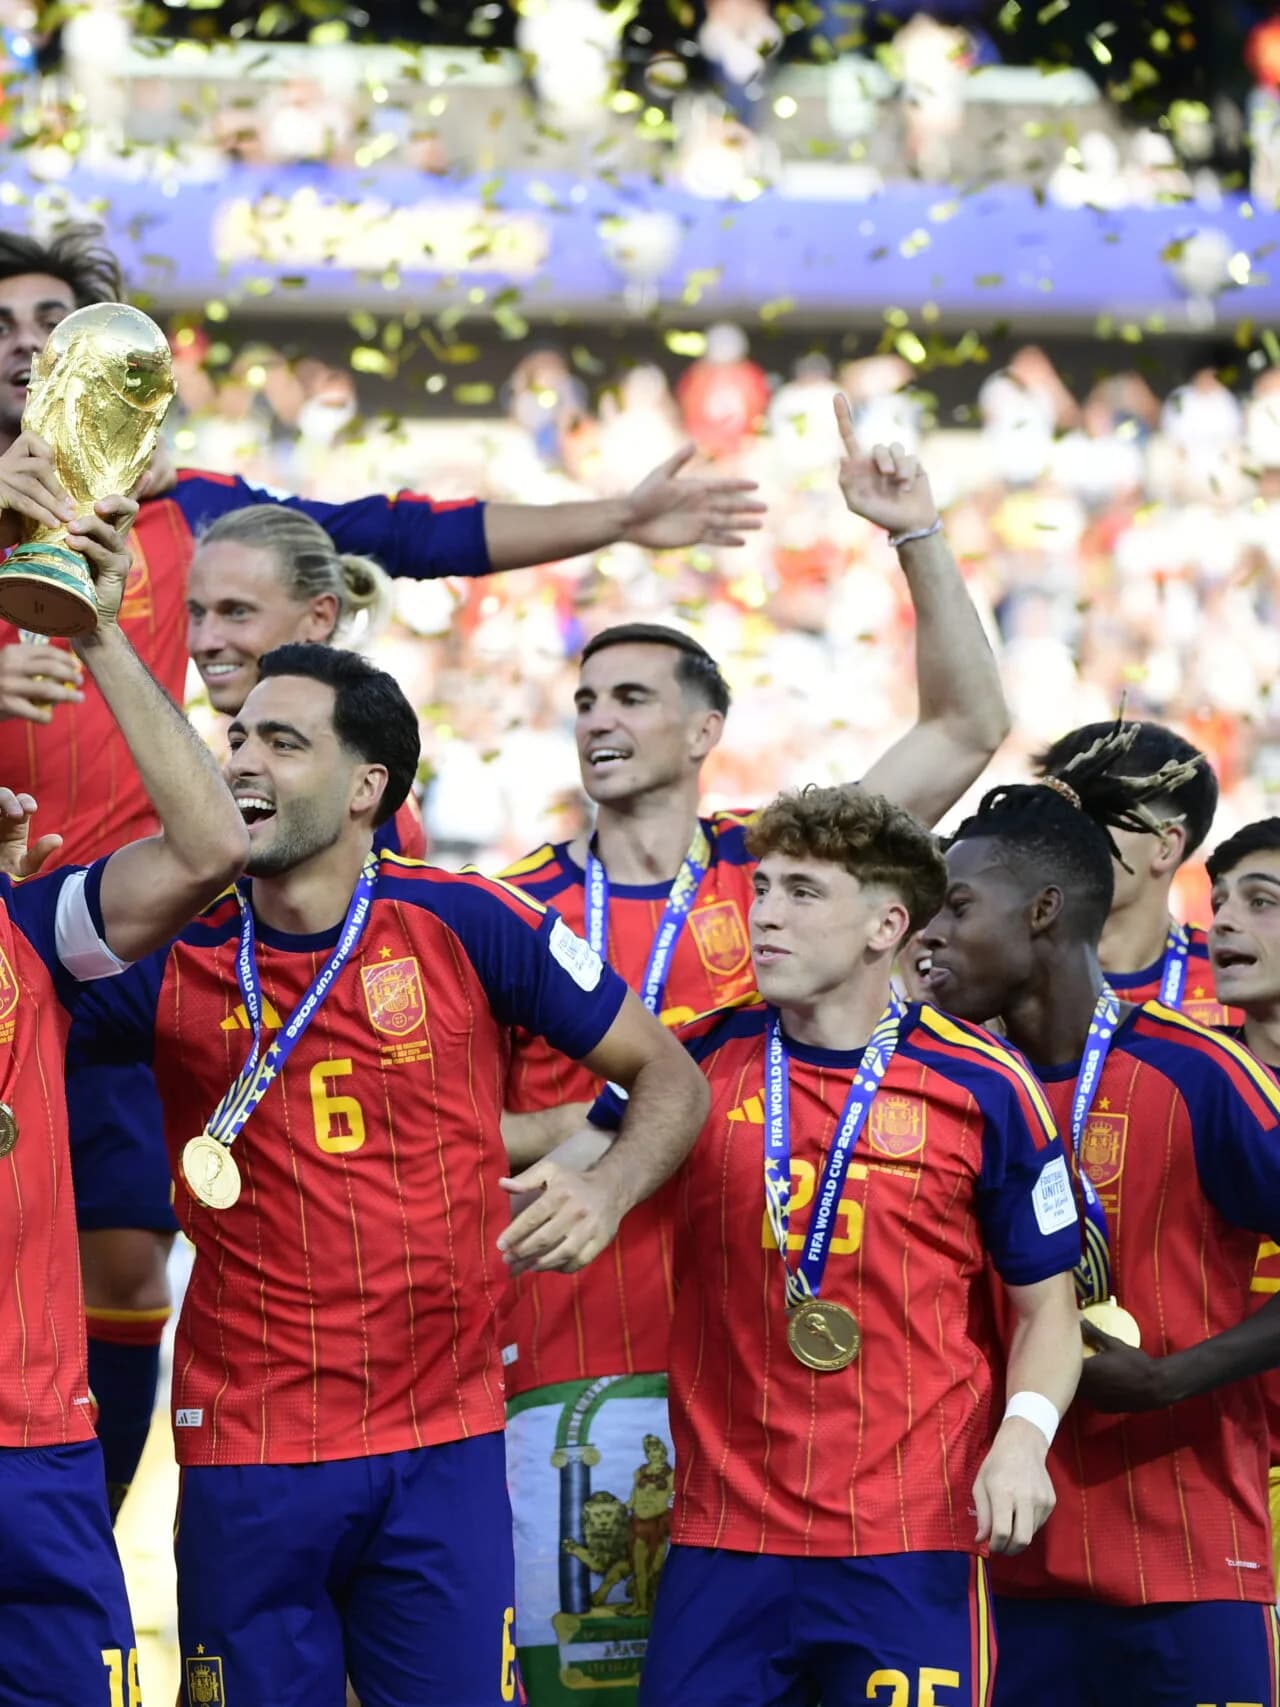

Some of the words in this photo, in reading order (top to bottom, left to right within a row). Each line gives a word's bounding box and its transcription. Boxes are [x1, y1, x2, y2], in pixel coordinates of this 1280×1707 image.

[352, 896, 371, 925] FIFA
[591, 881, 604, 908] CUP
[330, 925, 359, 971] WORLD
[590, 908, 604, 952] 2026
[657, 921, 677, 949] FIFA
[239, 944, 255, 992] WORLD
[247, 992, 259, 1020] CUP
[315, 969, 334, 996] CUP
[646, 948, 669, 996] WORLD
[1164, 958, 1183, 1002] 2026
[285, 993, 318, 1039] 2026
[770, 1036, 783, 1065] CUP
[309, 1057, 367, 1155] 6
[770, 1065, 783, 1117] WORLD
[1073, 1094, 1088, 1121] CUP
[1082, 1049, 1101, 1095] 2026
[771, 1116, 784, 1147] FIFA
[837, 1100, 864, 1150] 2026
[829, 1148, 845, 1179] CUP
[761, 1159, 869, 1255] 25
[815, 1178, 838, 1230] WORLD
[807, 1231, 826, 1262] FIFA
